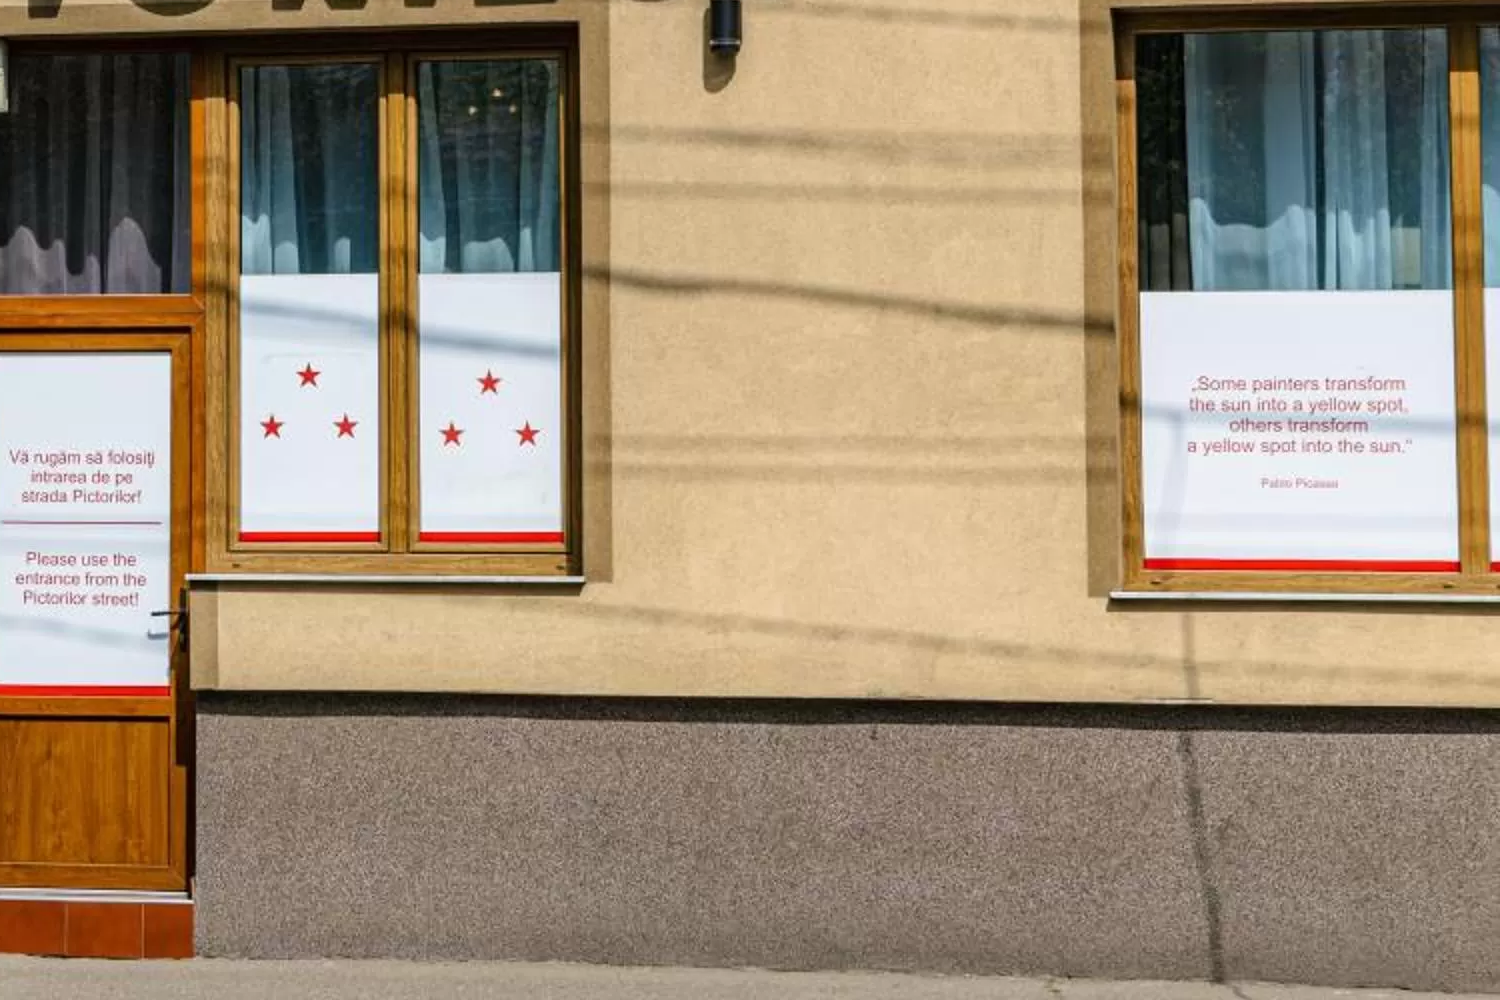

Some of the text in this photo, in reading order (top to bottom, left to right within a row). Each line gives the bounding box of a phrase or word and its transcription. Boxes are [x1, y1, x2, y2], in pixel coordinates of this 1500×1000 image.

[1251, 375, 1320, 394] painters
[1324, 375, 1406, 391] transform
[1189, 397, 1217, 413] the
[1221, 400, 1251, 413] sun
[1257, 397, 1287, 413] into
[1292, 400, 1303, 413] a
[1308, 397, 1363, 416] yellow
[1229, 416, 1369, 433] others transform
[1187, 440, 1197, 453] a
[1202, 438, 1256, 456] yellow
[1259, 439, 1297, 456] spot
[1301, 438, 1333, 453] into
[1337, 438, 1365, 453] the
[9, 449, 29, 465] Vă
[33, 450, 81, 468] rugăm
[85, 450, 104, 465] să
[30, 469, 134, 487] intrarea de pe
[20, 489, 143, 505] strada Pictorilor!
[25, 551, 137, 567] Please use the
[14, 571, 147, 587] entrance from the
[23, 589, 140, 608] Pictorilor street!
